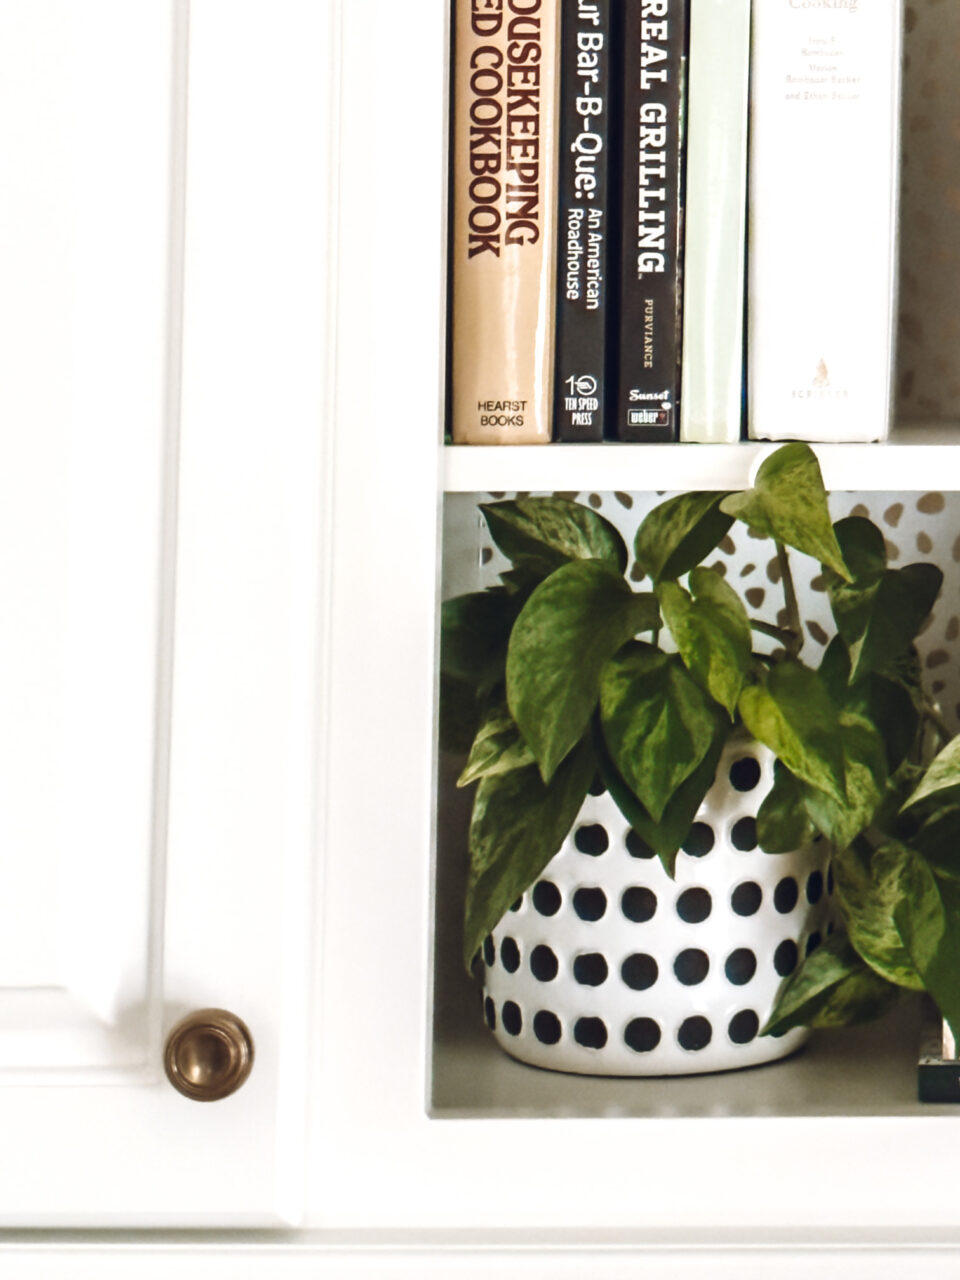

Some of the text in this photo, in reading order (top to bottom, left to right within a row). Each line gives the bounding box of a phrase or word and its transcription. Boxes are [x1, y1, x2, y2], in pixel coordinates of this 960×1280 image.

[570, 32, 604, 200] Bar-B-Que:
[467, 44, 504, 260] COOKBOOK
[637, 102, 667, 274] GRILLING
[566, 208, 585, 300] Roadhouse
[586, 208, 603, 310] An American
[643, 298, 654, 369] PURVIANCE
[477, 400, 528, 413] HEARST
[564, 397, 599, 411] TEN SPEED
[629, 389, 670, 401] Sunset
[630, 409, 659, 424] weber
[480, 414, 524, 427] BOOKS
[571, 412, 592, 426] PRESS
